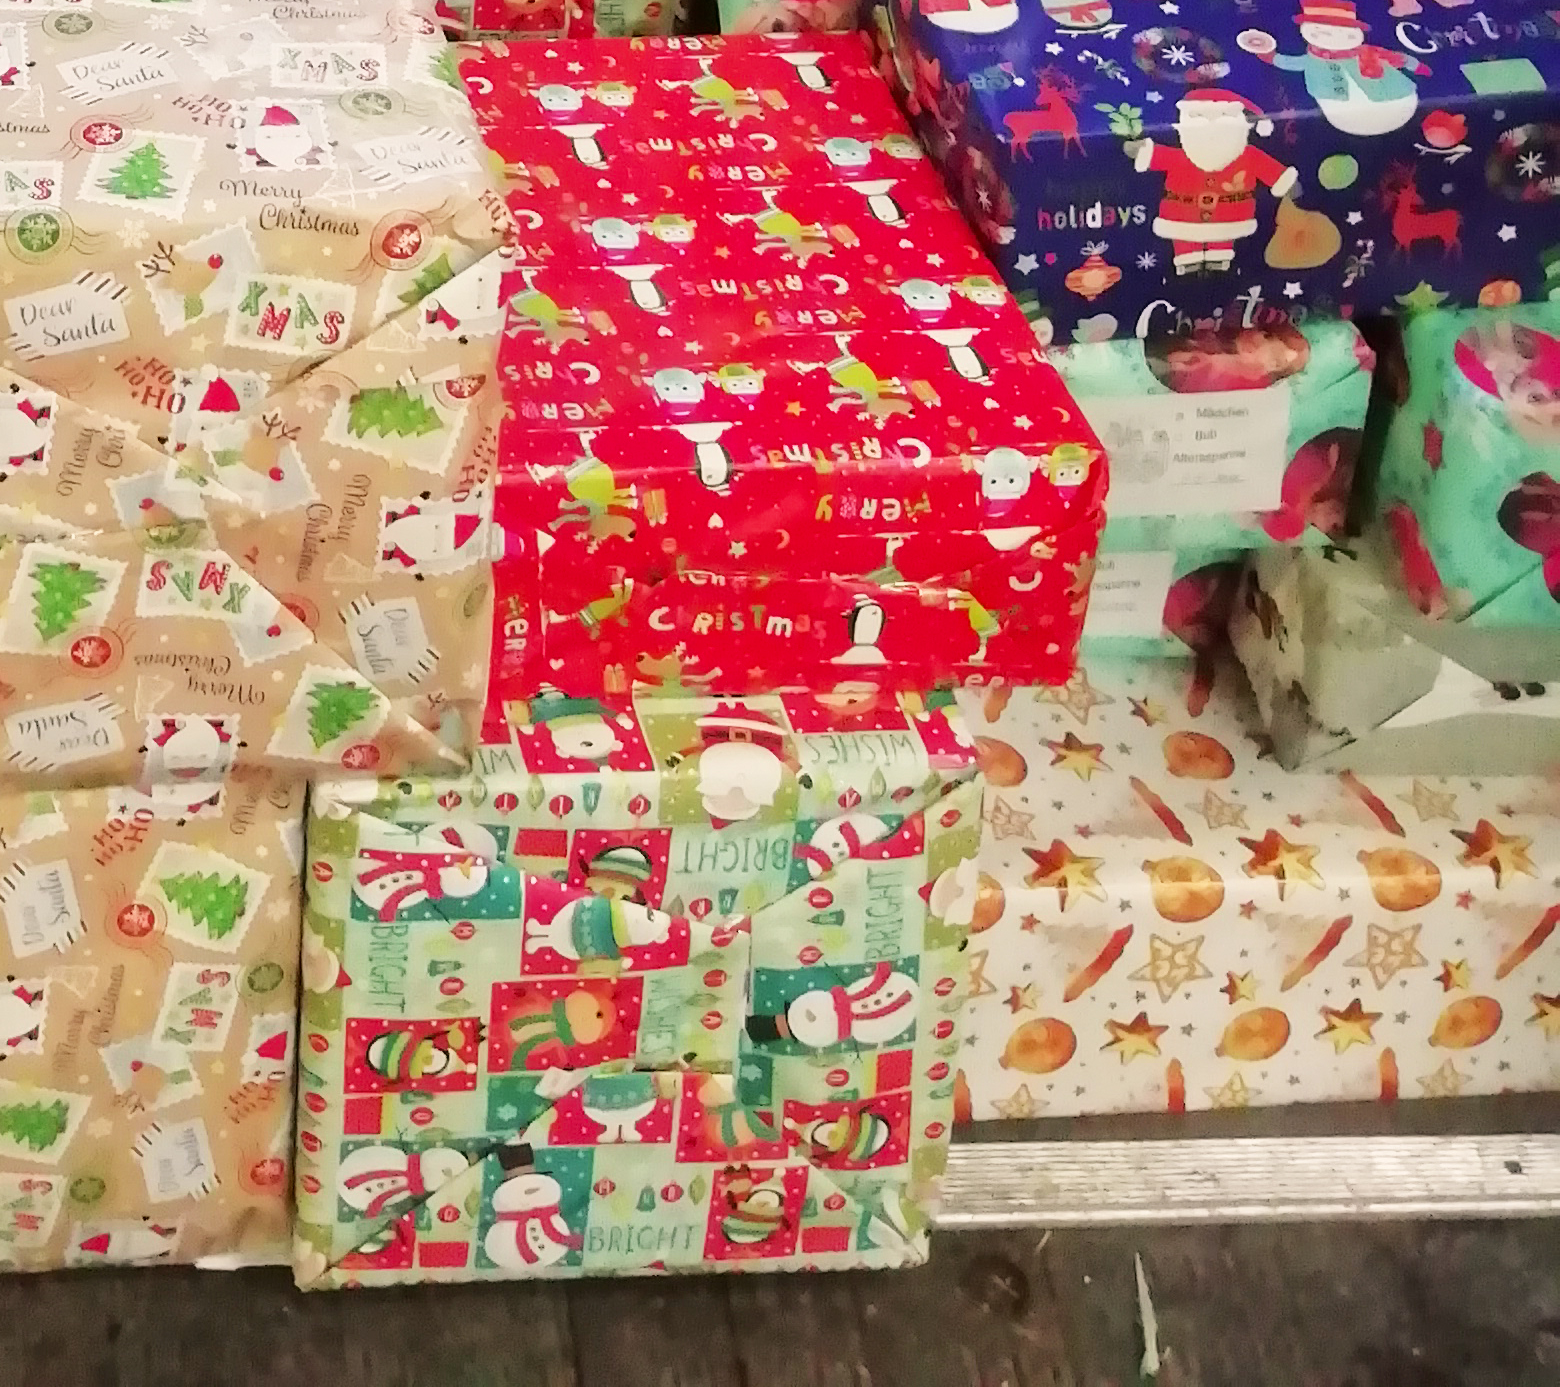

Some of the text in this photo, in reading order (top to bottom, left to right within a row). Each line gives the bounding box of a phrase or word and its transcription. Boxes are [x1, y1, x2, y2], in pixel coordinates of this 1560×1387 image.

[277, 47, 381, 83] XMAS
[219, 179, 303, 207] Merry
[259, 203, 361, 236] Christmas
[1038, 200, 1147, 230] holidays
[19, 297, 77, 327] Dear
[237, 280, 346, 345] XMAS
[43, 312, 118, 348] Santa
[141, 385, 187, 415] HO
[146, 560, 252, 614] XMAS
[804, 734, 915, 765] WISHES
[673, 837, 788, 874] BRIGHT
[863, 867, 906, 960] BRIGHT
[367, 924, 409, 1014] BRIGHT
[587, 1224, 695, 1257] BRIGHT
